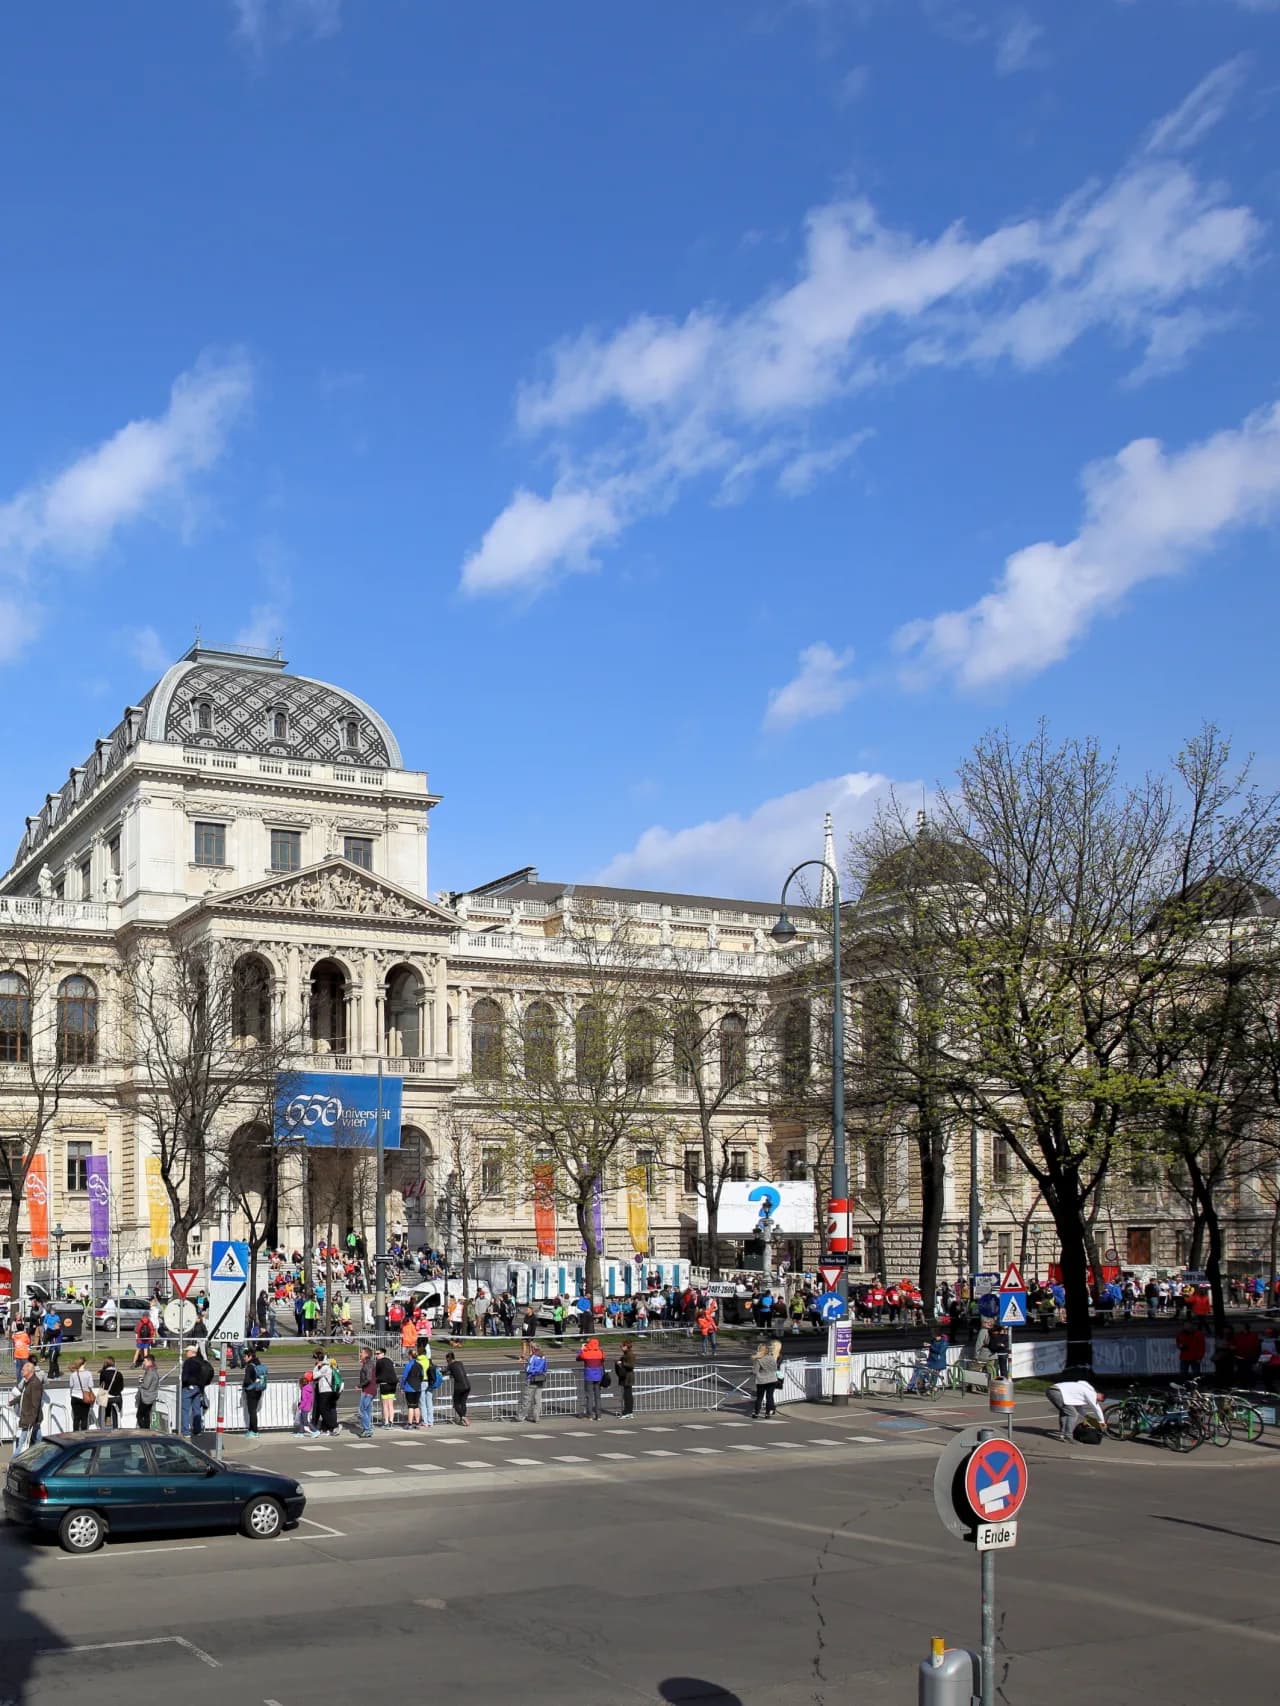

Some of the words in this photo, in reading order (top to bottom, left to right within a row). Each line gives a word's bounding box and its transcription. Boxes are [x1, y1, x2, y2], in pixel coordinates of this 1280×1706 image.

[340, 1108, 391, 1120] universiät
[214, 1329, 240, 1340] Zone
[984, 1528, 1011, 1545] Ende
